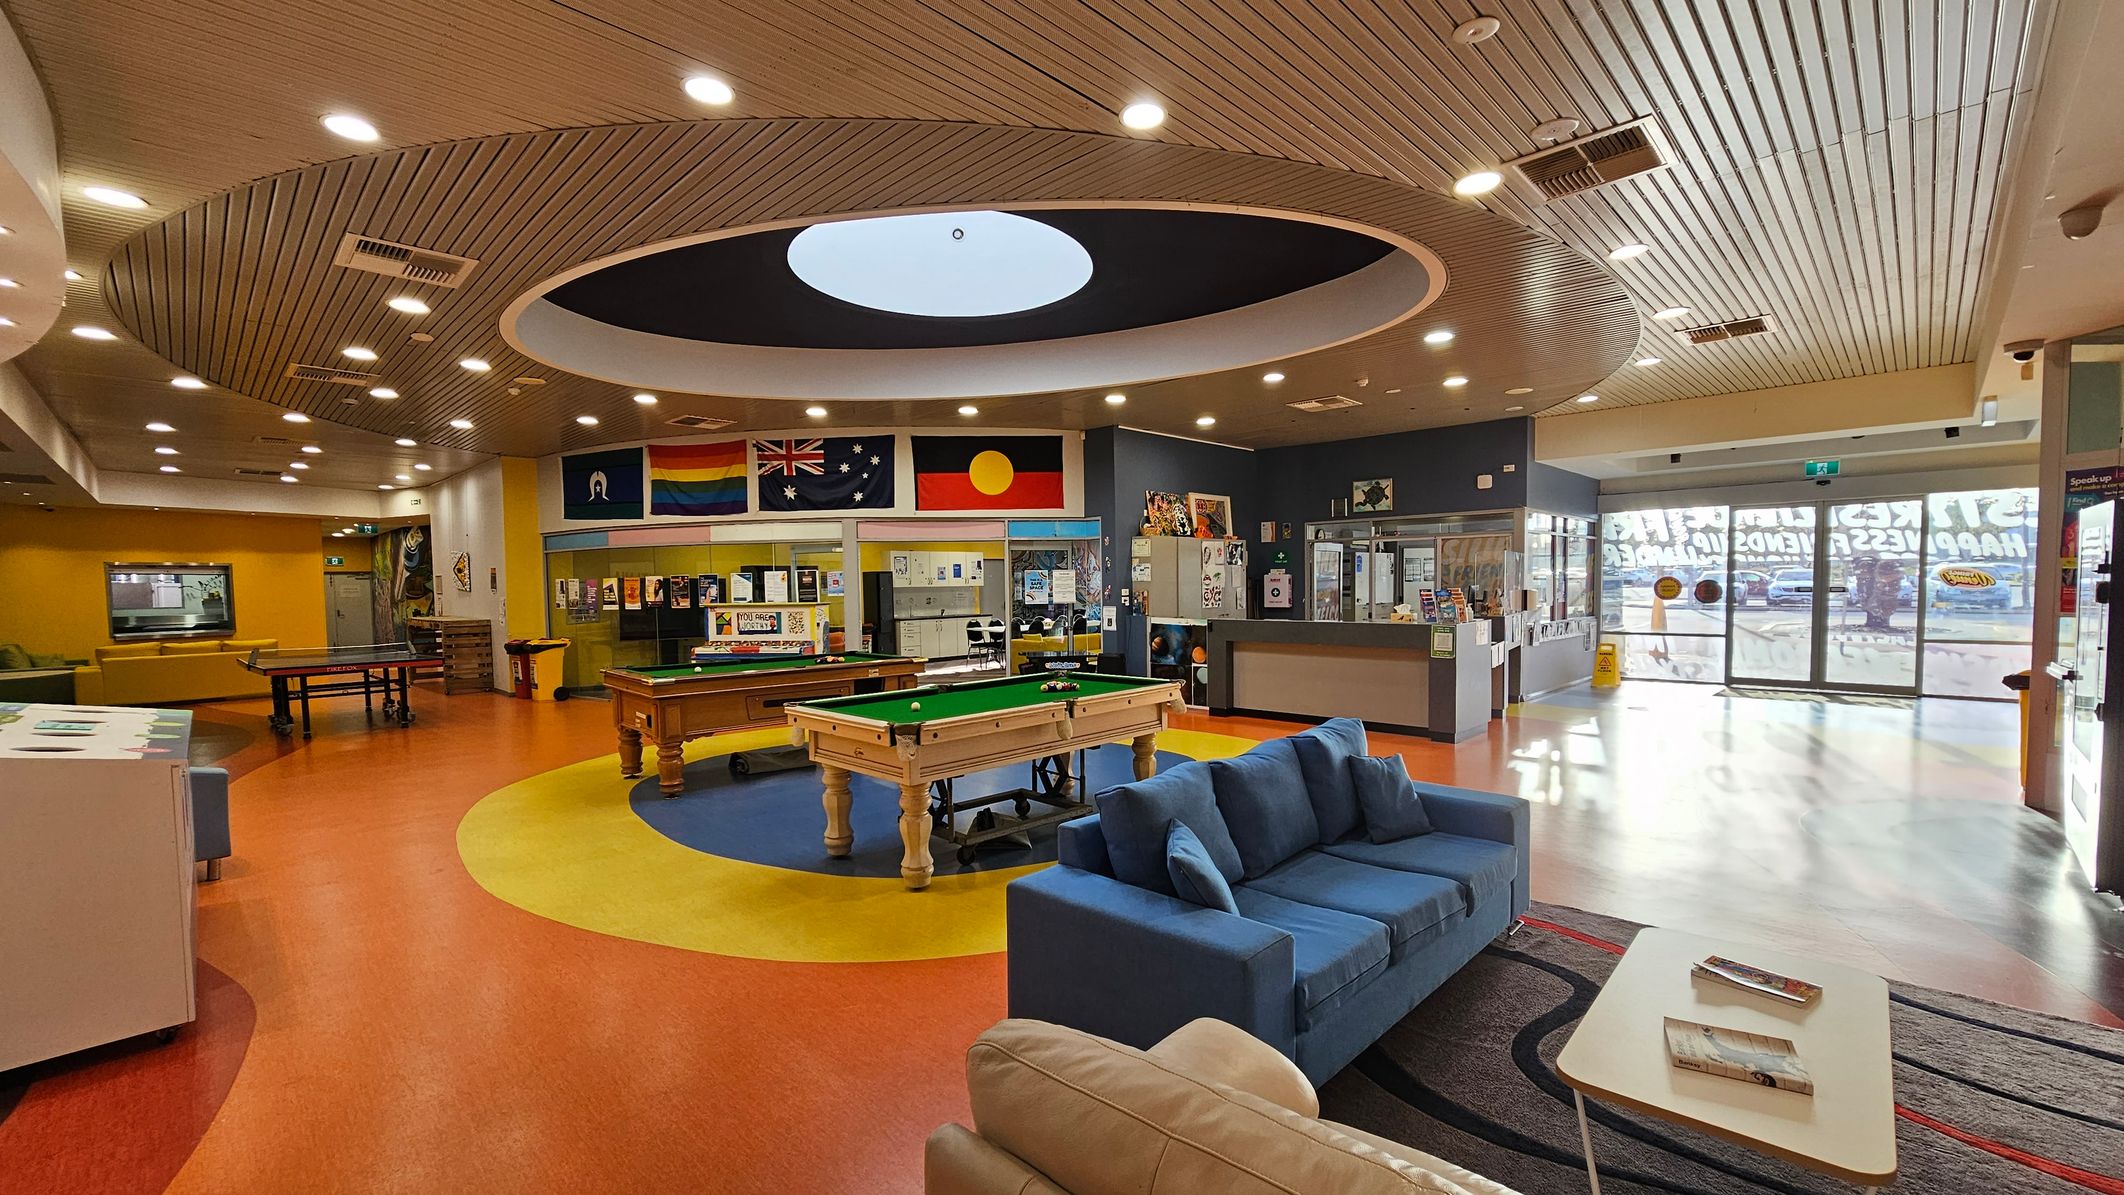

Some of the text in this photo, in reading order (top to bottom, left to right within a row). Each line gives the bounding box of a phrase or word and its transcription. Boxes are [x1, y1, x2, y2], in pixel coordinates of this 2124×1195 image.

[2070, 475, 2098, 486] Speak
[739, 612, 769, 621] YOU ARE
[1679, 1060, 1700, 1068] Banksy
